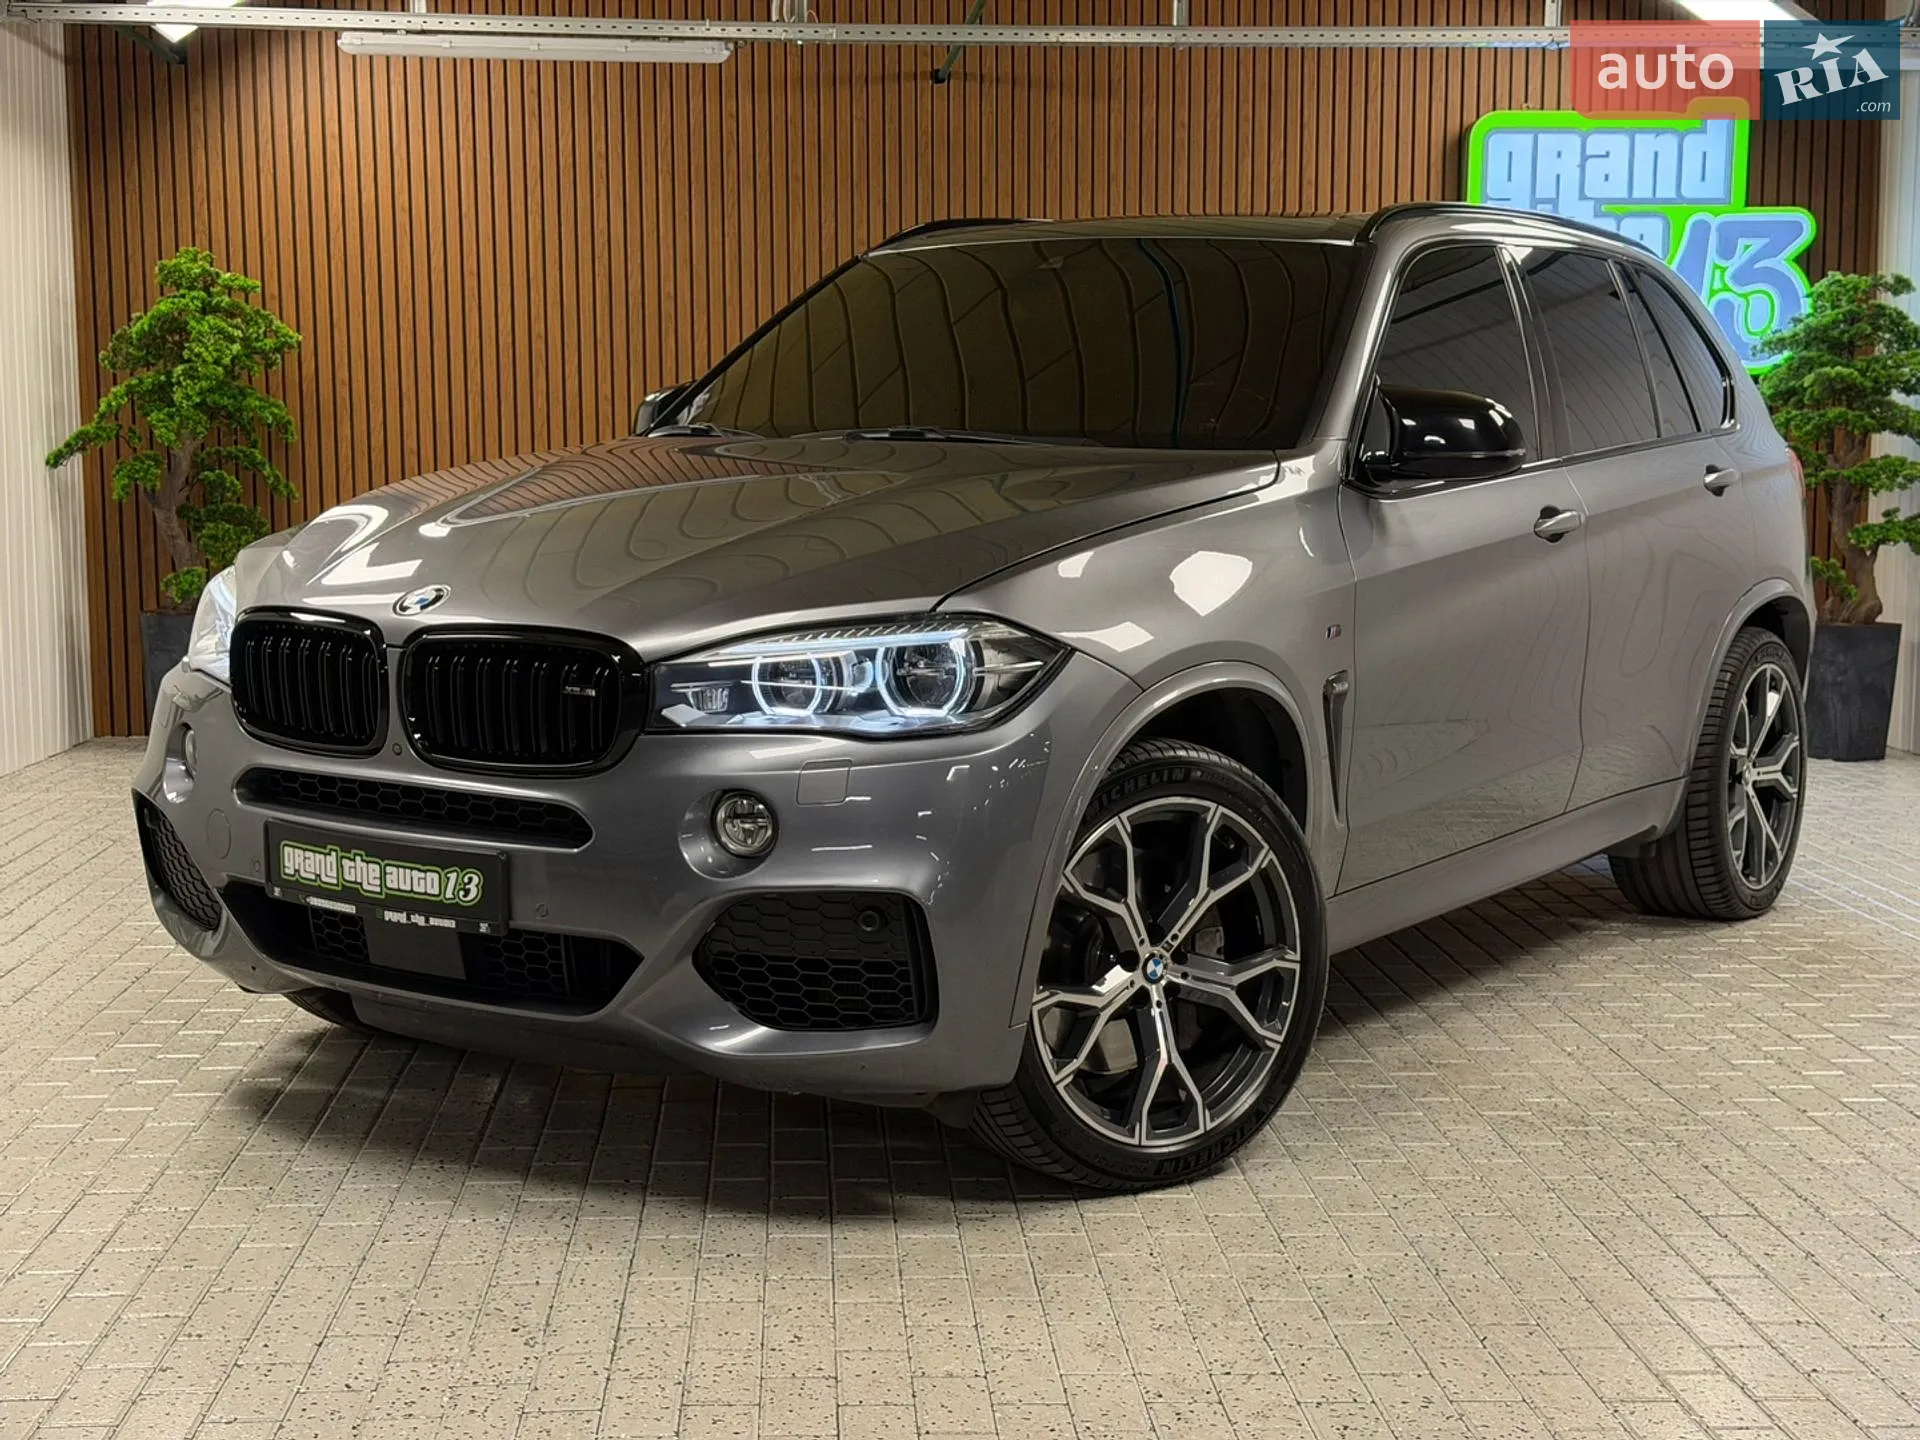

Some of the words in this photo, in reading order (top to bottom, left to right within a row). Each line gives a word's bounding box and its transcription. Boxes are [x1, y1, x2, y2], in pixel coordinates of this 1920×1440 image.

[341, 855, 382, 892] the
[385, 864, 440, 895] auto
[443, 869, 483, 903] 13
